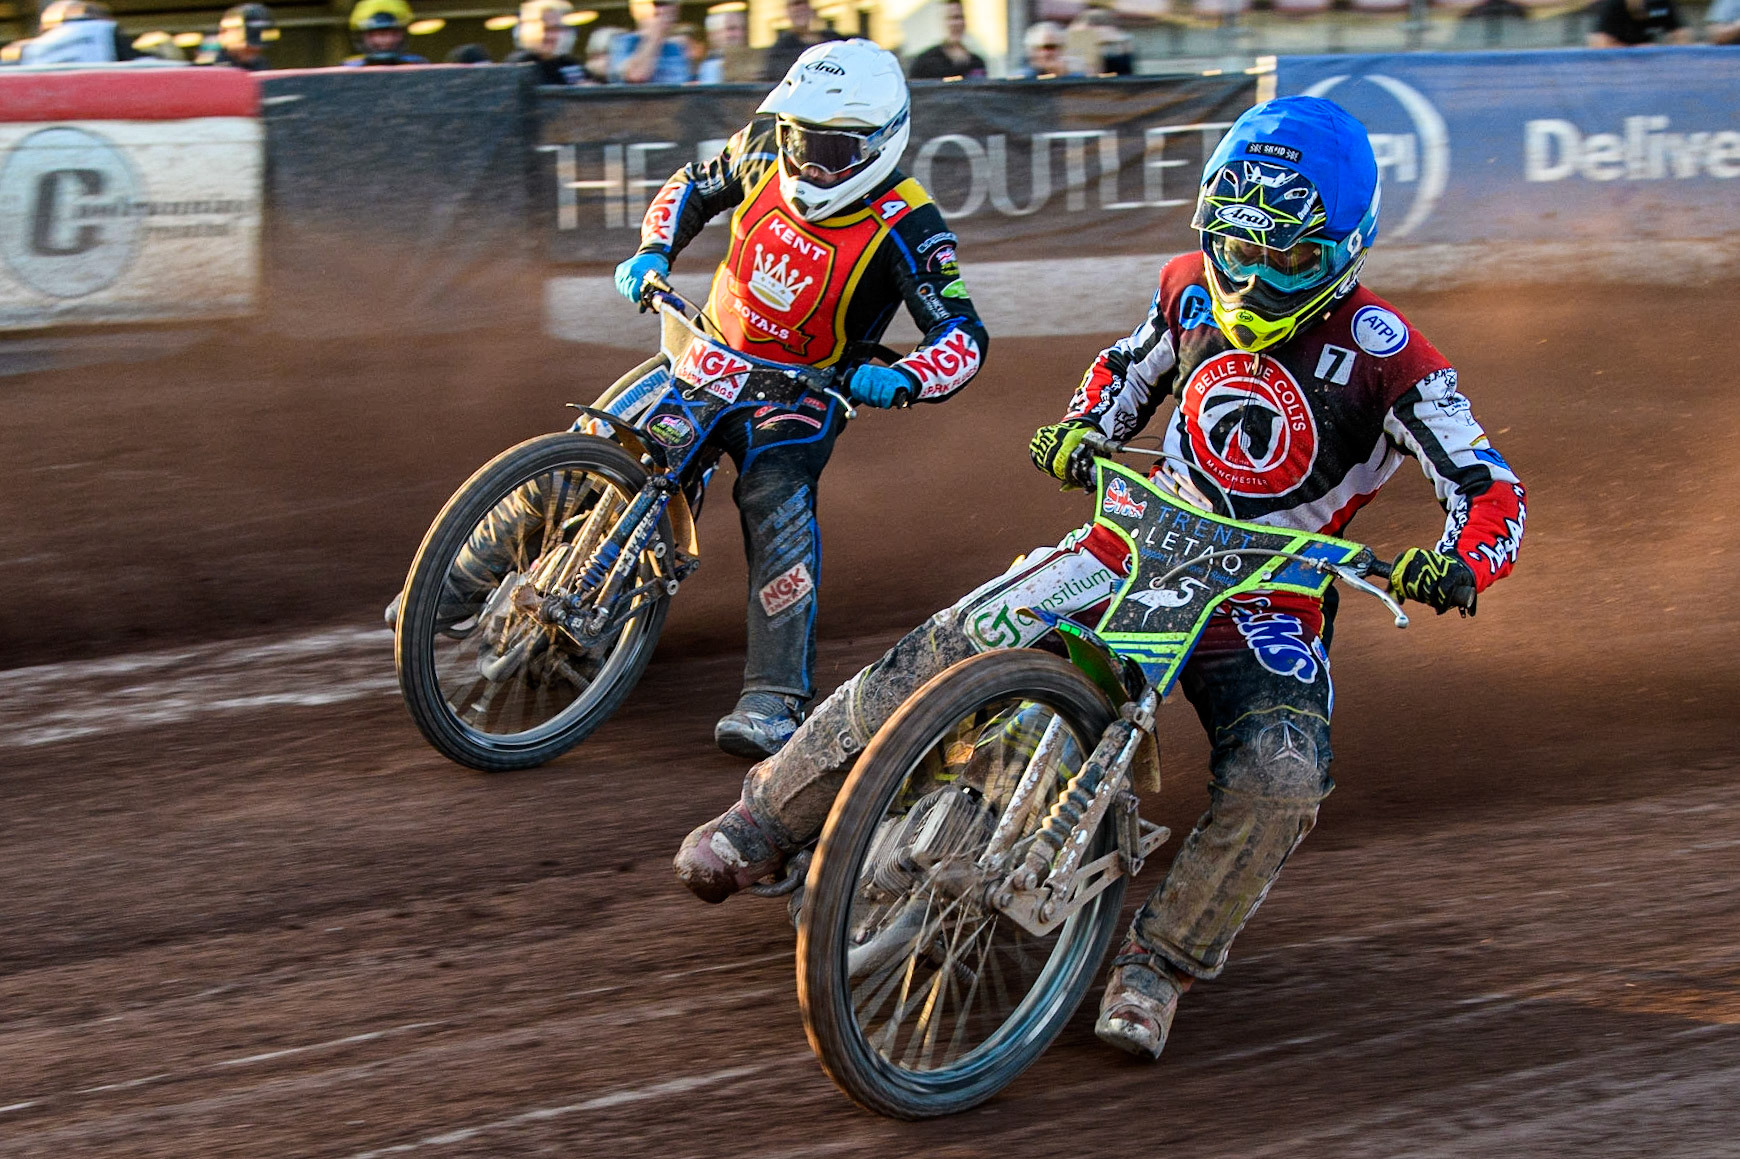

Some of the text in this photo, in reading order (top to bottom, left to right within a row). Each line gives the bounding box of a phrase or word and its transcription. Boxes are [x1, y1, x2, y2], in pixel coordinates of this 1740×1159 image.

[880, 200, 908, 220] 4
[1227, 206, 1268, 227] Arai
[768, 218, 827, 261] KENT
[733, 298, 790, 340] ROYALS
[1362, 315, 1398, 344] ATPI
[682, 343, 748, 389] NGK
[904, 333, 977, 384] NGK
[1324, 347, 1348, 382] 7
[705, 380, 735, 400] LUGS
[1194, 360, 1237, 396] BELLE
[1274, 380, 1307, 432] COLTS
[1206, 458, 1268, 486] MANCHESTER
[1156, 505, 1253, 551] TRENT
[763, 567, 806, 606] NGK
[1016, 568, 1112, 626] Cnsilium
